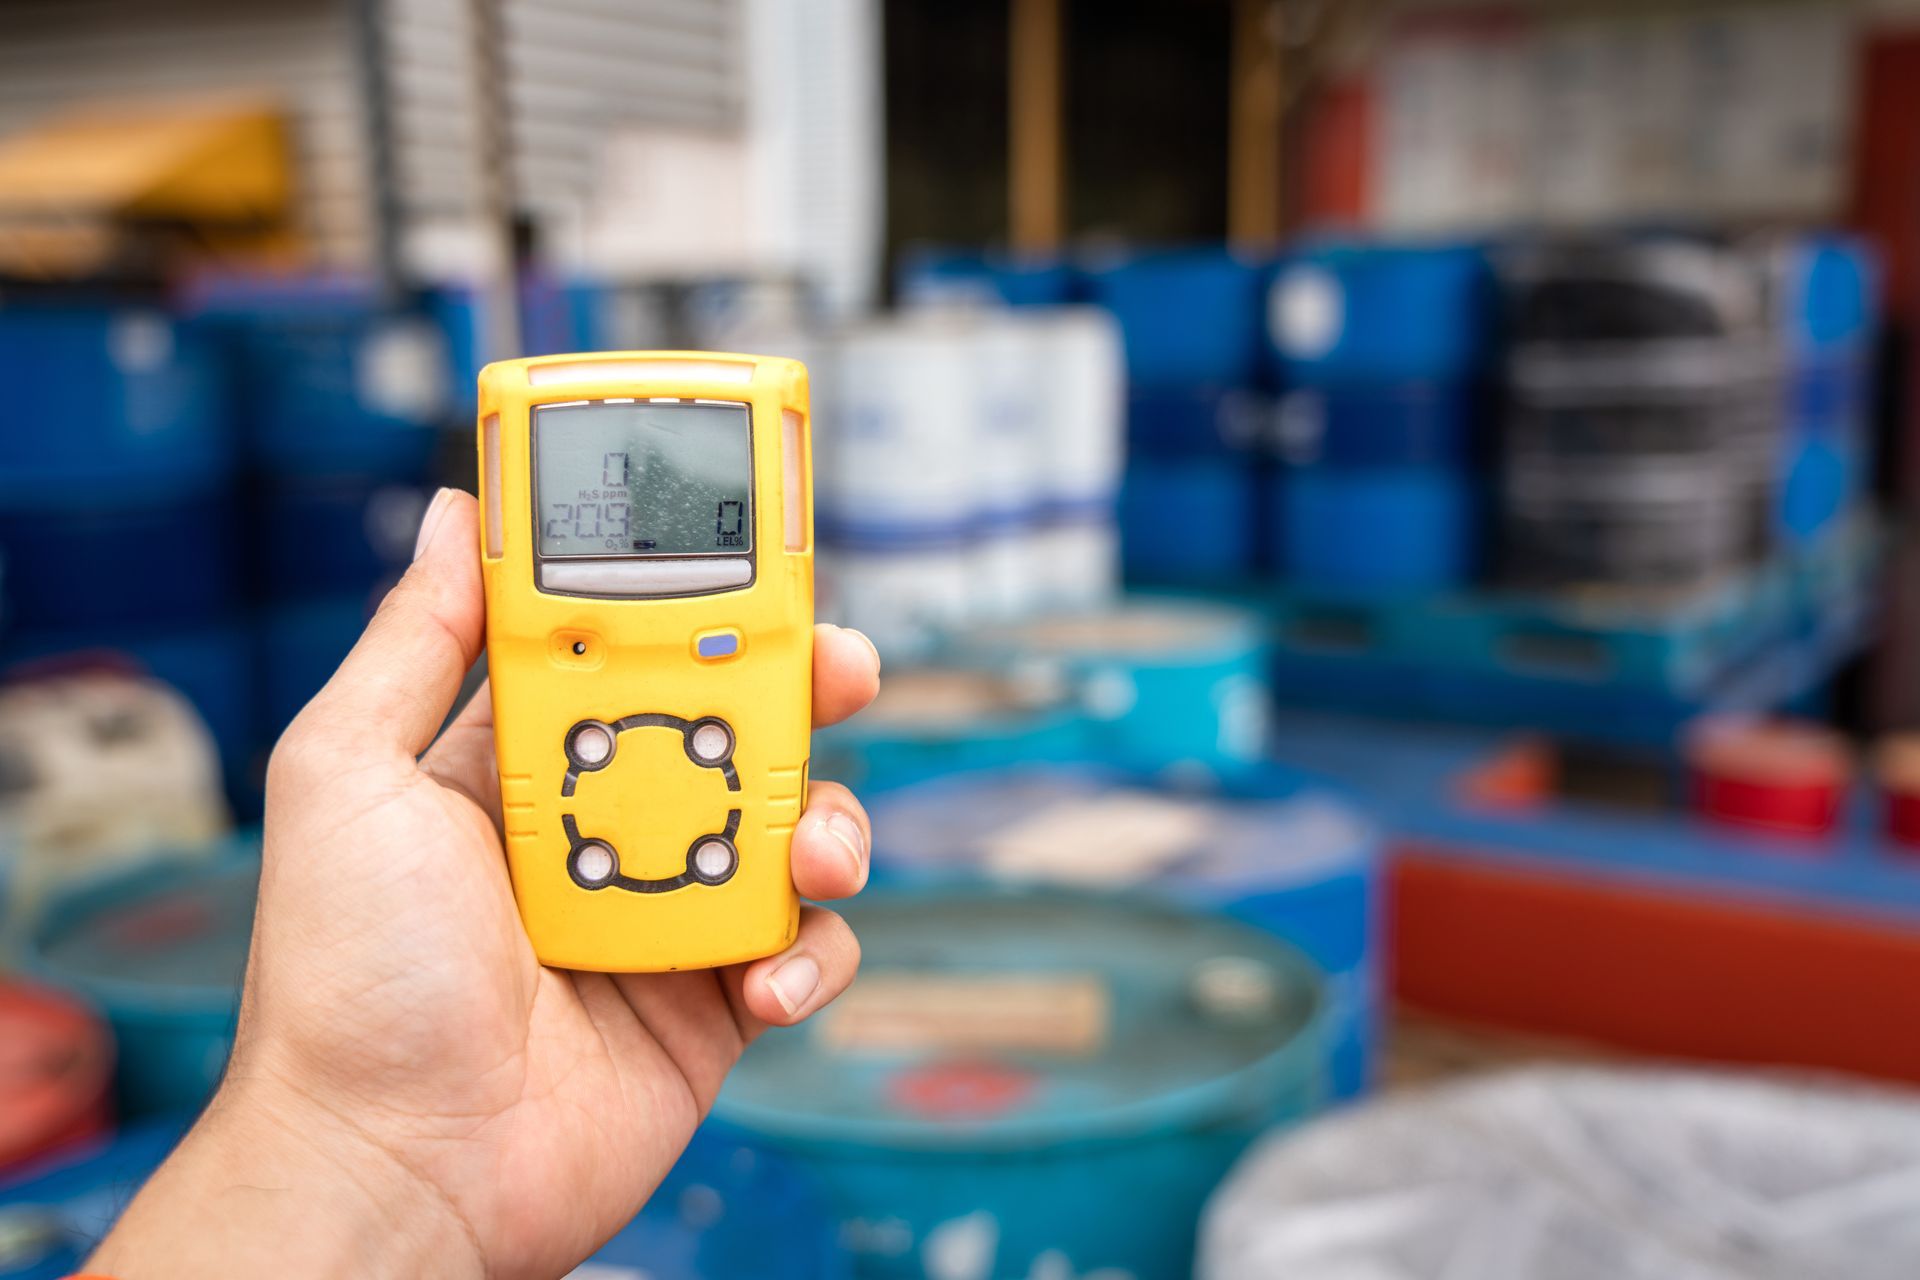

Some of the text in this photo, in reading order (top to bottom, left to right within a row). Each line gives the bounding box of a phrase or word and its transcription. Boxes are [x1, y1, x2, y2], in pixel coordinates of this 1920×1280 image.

[603, 453, 629, 487] 0
[602, 491, 628, 499] ppm
[546, 503, 631, 539] 20.9
[717, 501, 743, 535] 0
